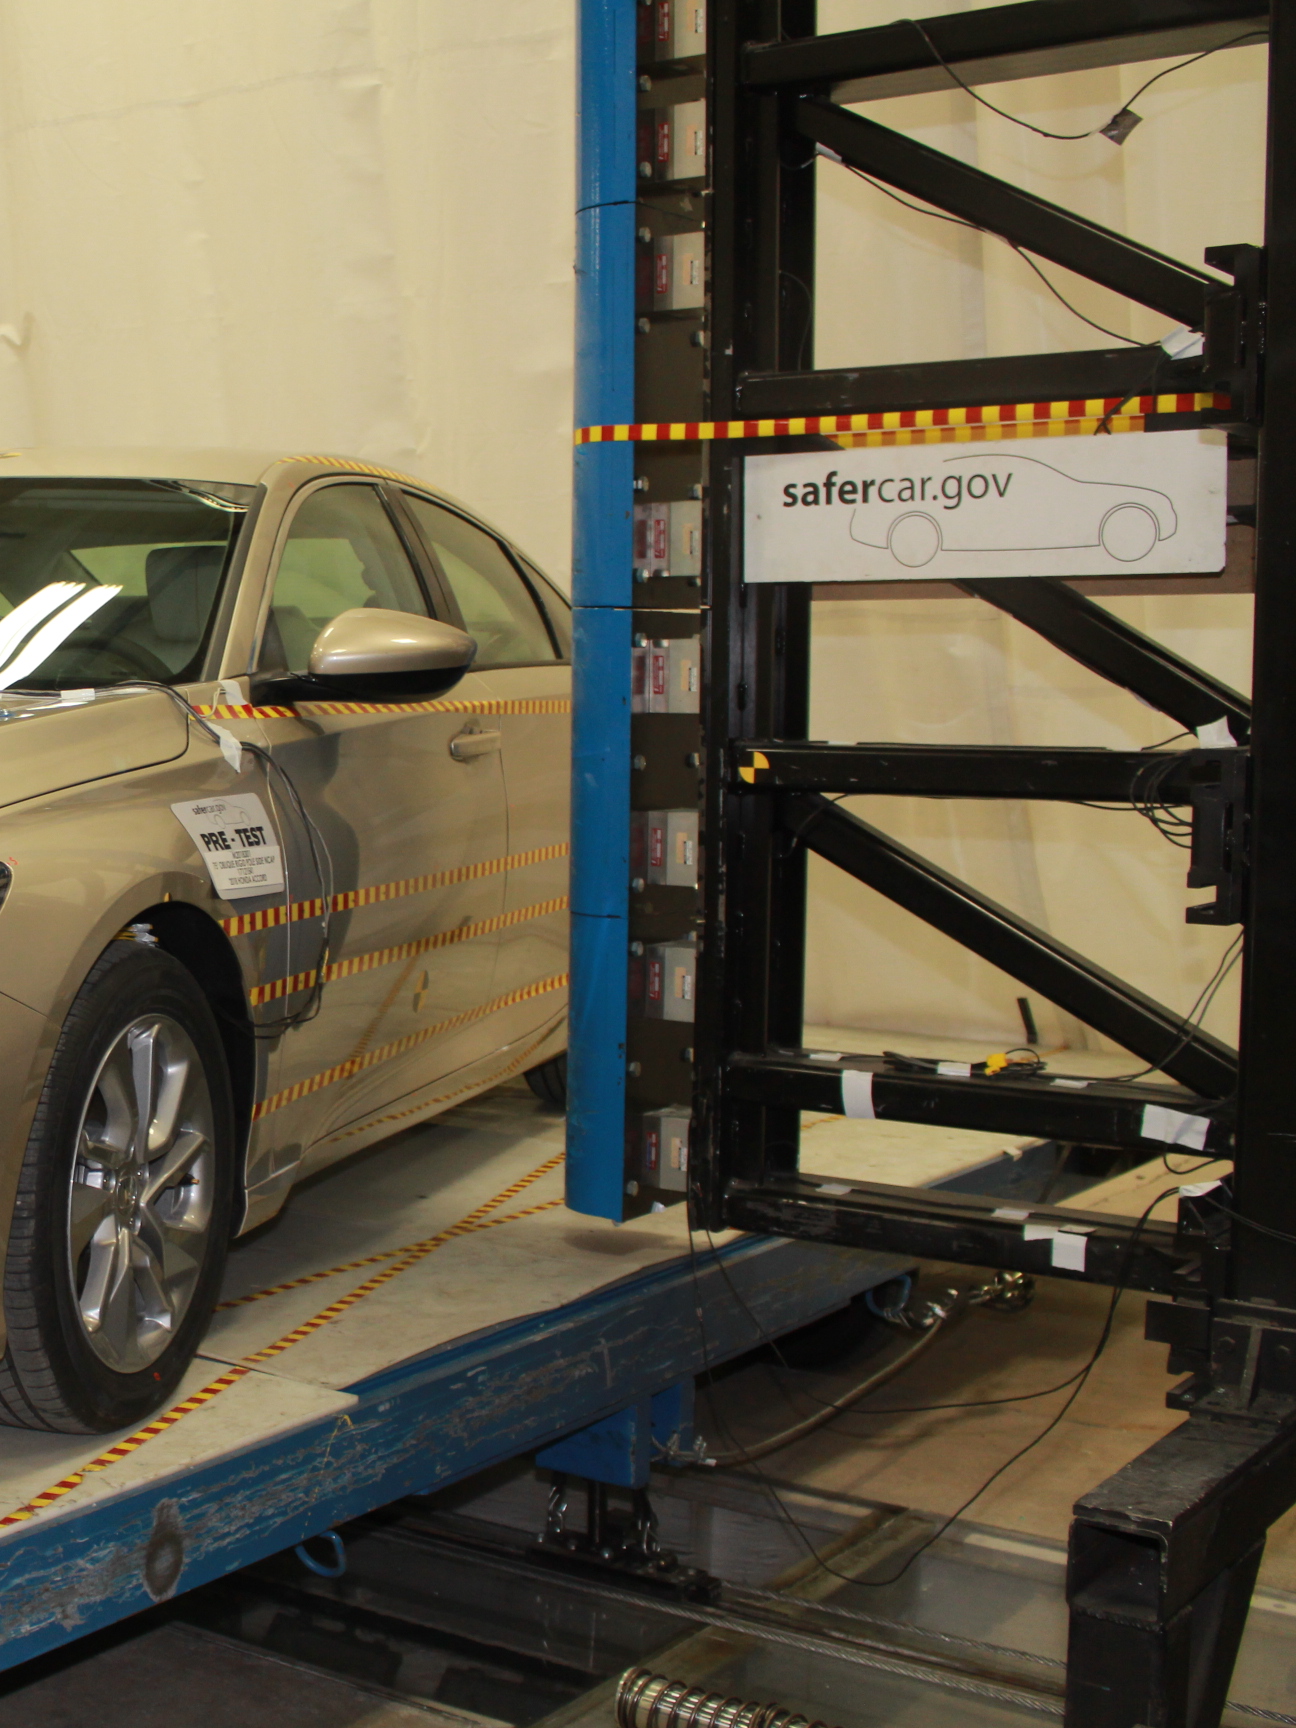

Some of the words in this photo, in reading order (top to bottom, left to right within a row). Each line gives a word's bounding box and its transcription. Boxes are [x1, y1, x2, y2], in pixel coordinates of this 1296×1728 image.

[782, 470, 1013, 510] safercar.gov
[200, 831, 231, 851] PRE
[234, 826, 266, 848] TEST
